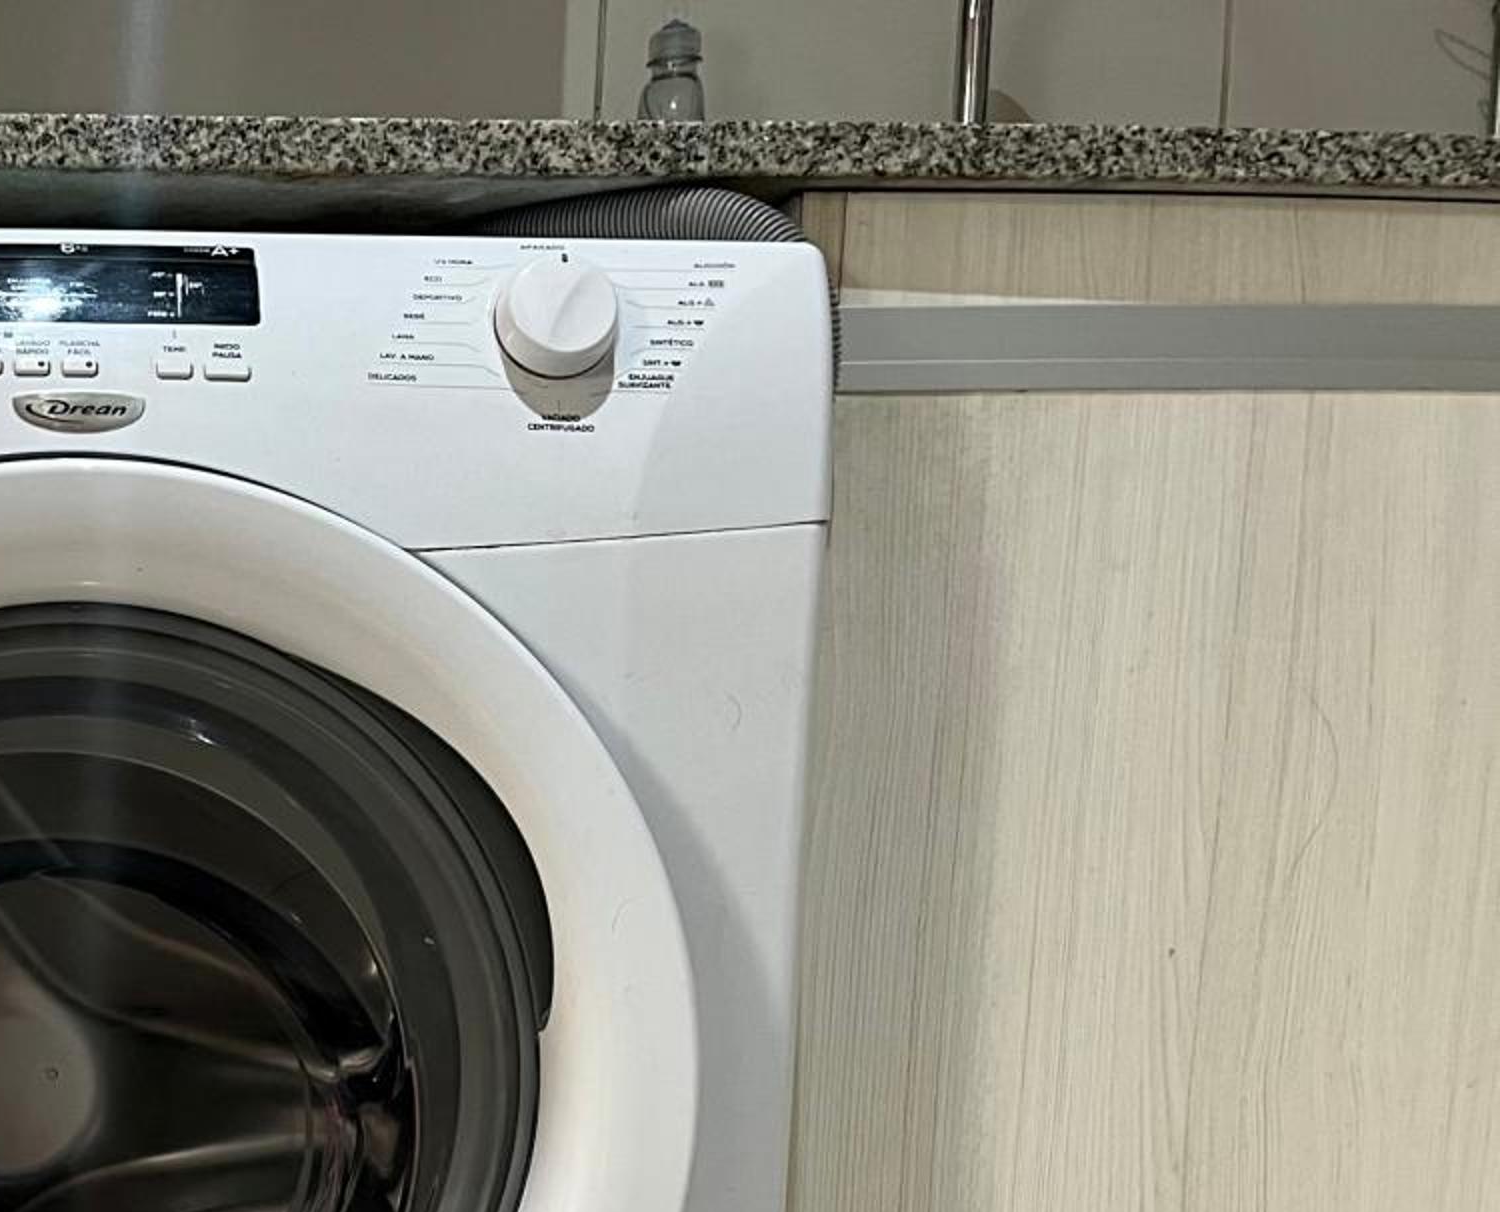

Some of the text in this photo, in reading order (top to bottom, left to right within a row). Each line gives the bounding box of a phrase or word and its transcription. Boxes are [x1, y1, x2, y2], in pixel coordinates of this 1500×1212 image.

[211, 244, 240, 257] A+
[368, 371, 417, 383] DELICADOS
[46, 399, 128, 418] Drean
[527, 422, 595, 433] CENTRIFUGADO
